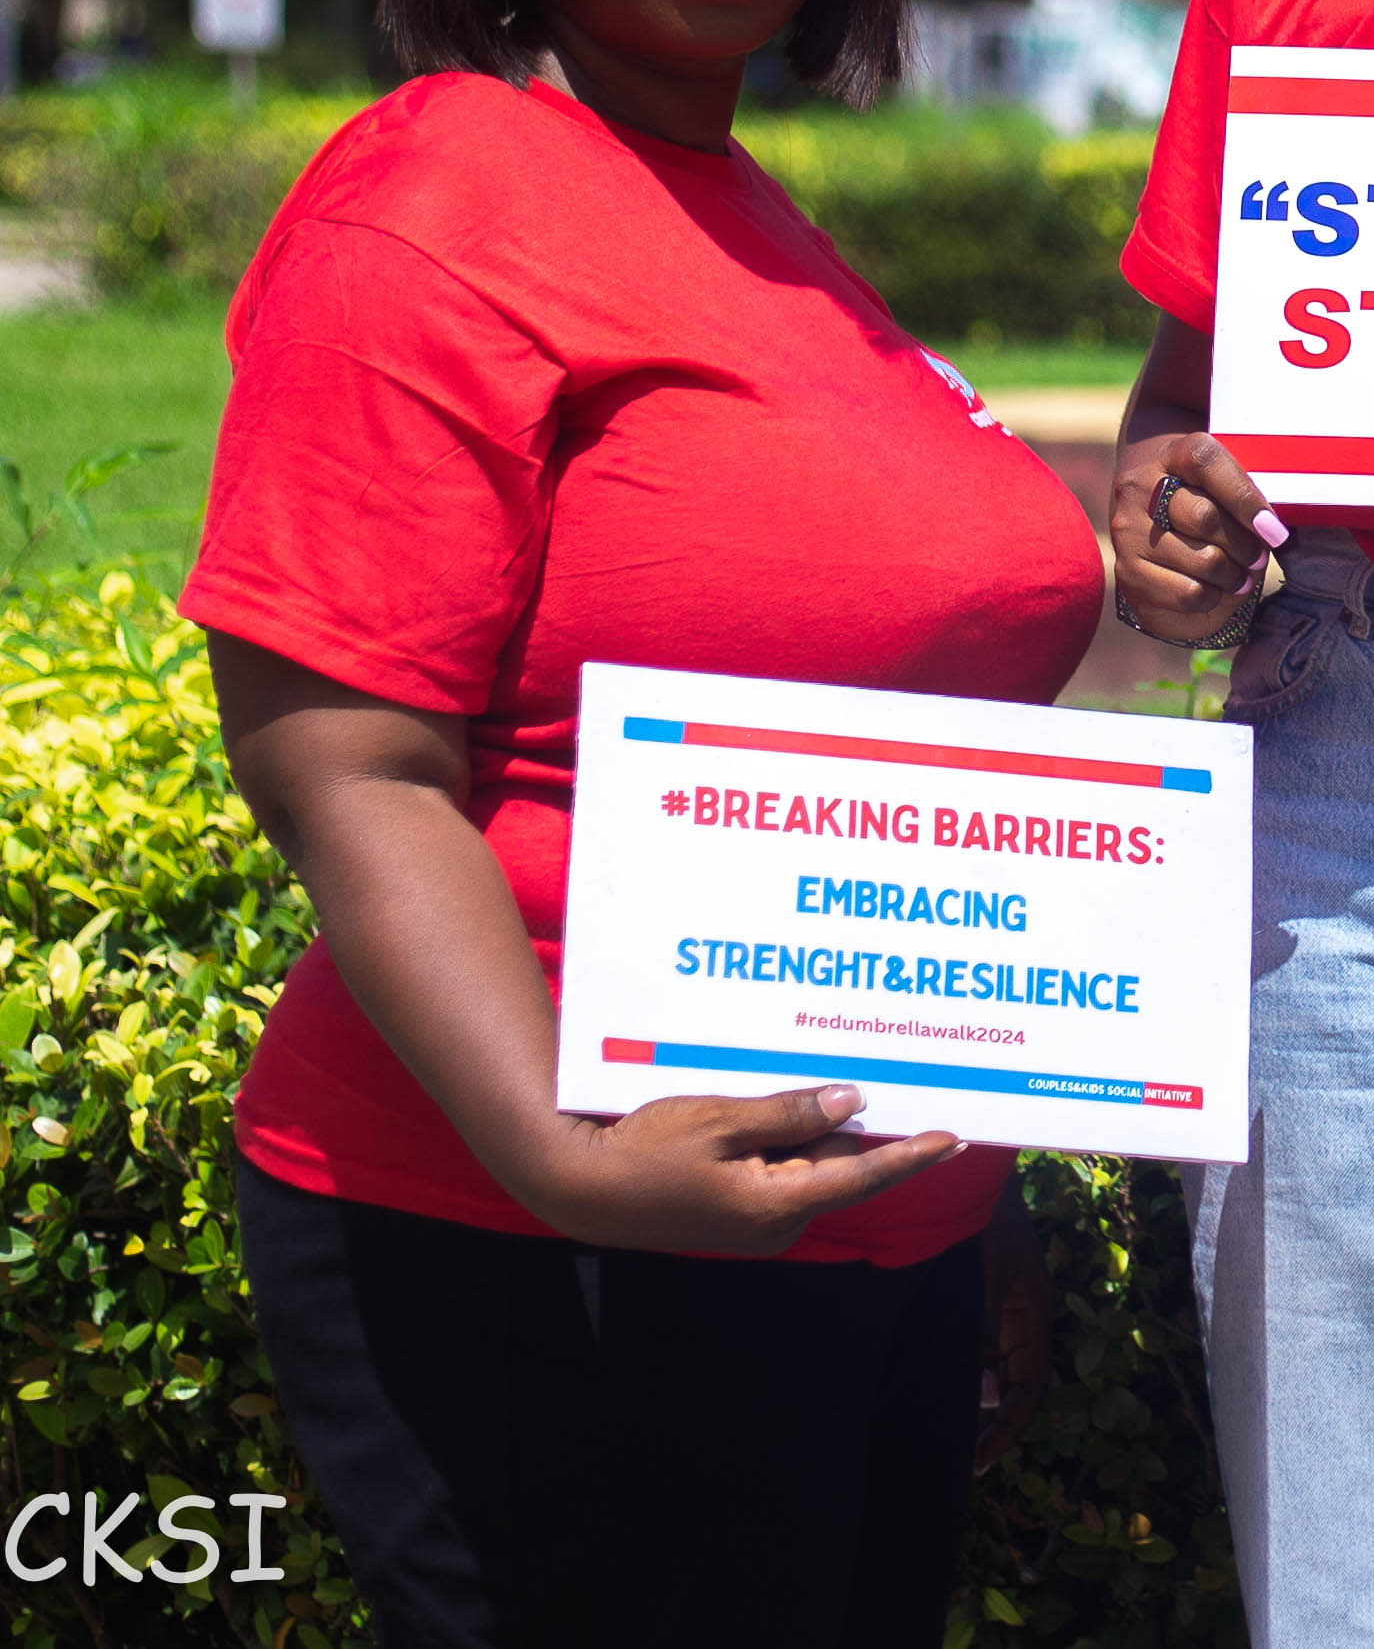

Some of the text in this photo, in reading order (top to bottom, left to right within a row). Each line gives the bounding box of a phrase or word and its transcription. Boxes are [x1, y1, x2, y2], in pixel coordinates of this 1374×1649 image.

[661, 785, 1165, 865] #BREAKING BARRIERS:
[796, 875, 1027, 932] EMBRACING
[675, 937, 1140, 1013] STRENGHT&RESILIENCE
[795, 1012, 1026, 1045] #redumbrellawalk2024
[1028, 1078, 1192, 1102] COUPLES&KIDS SOCIAL INITIATIVE
